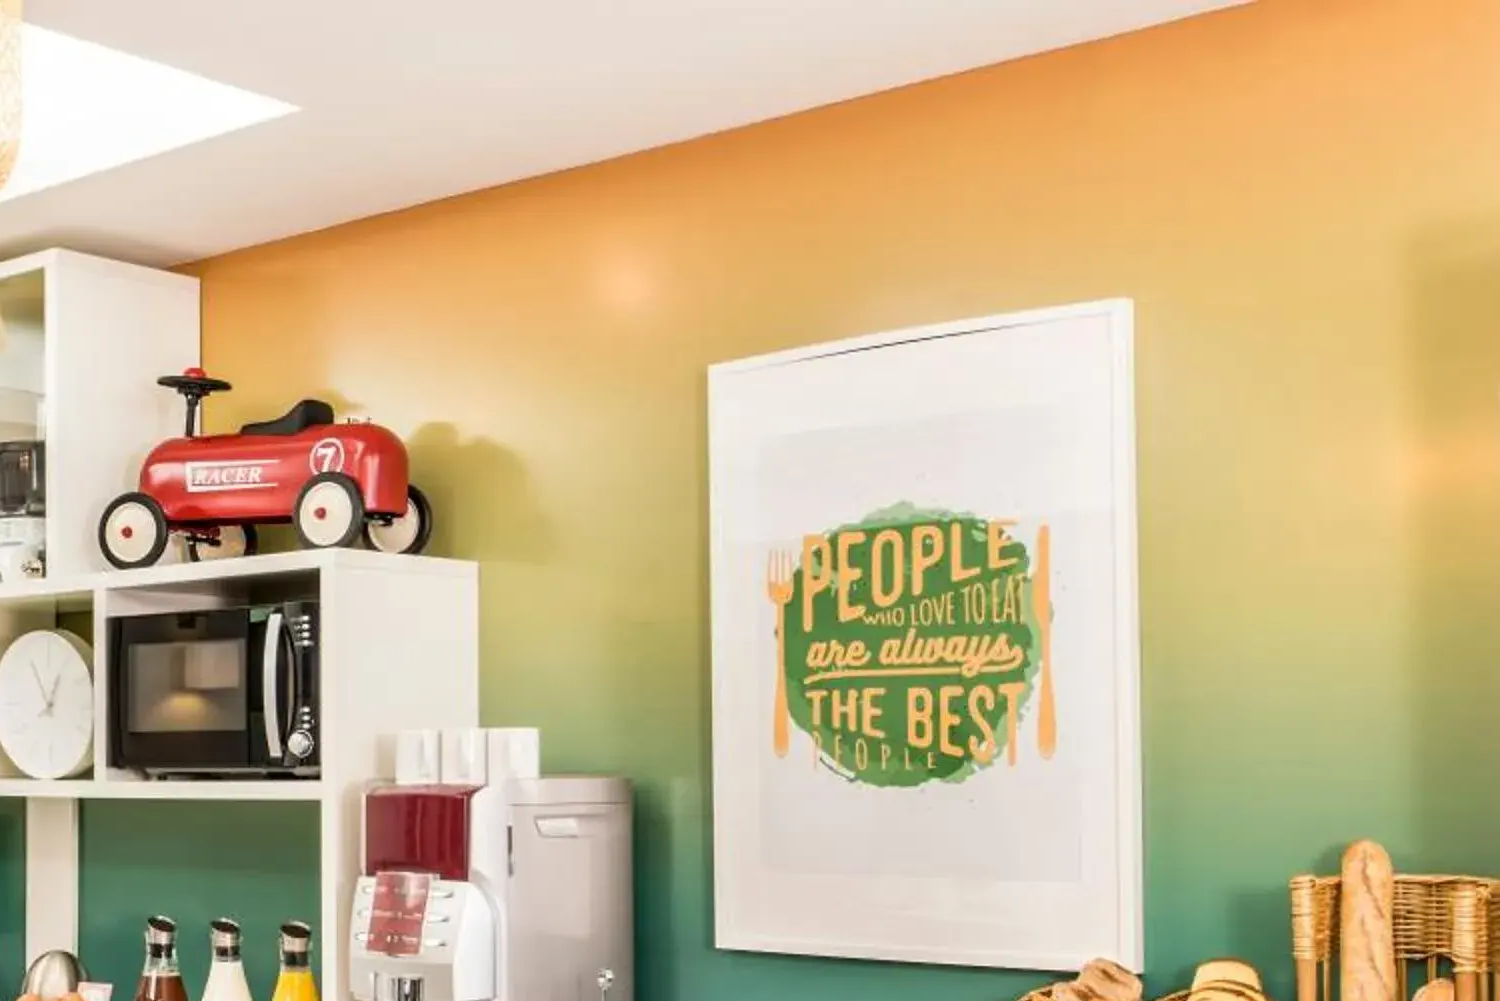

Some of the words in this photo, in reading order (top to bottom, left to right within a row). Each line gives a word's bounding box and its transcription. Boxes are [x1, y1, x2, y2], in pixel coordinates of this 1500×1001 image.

[194, 465, 263, 484] RACER
[316, 446, 337, 473] 7
[802, 517, 1020, 633] PEOPLE
[863, 607, 905, 627] WHO
[910, 591, 956, 627] LOVE
[961, 582, 987, 625] TO
[991, 573, 1028, 625] EAT
[805, 639, 872, 669] are
[878, 628, 1024, 678] always
[805, 687, 887, 739] THE
[907, 681, 1026, 767] BEST
[811, 730, 938, 771] PEOPLE
